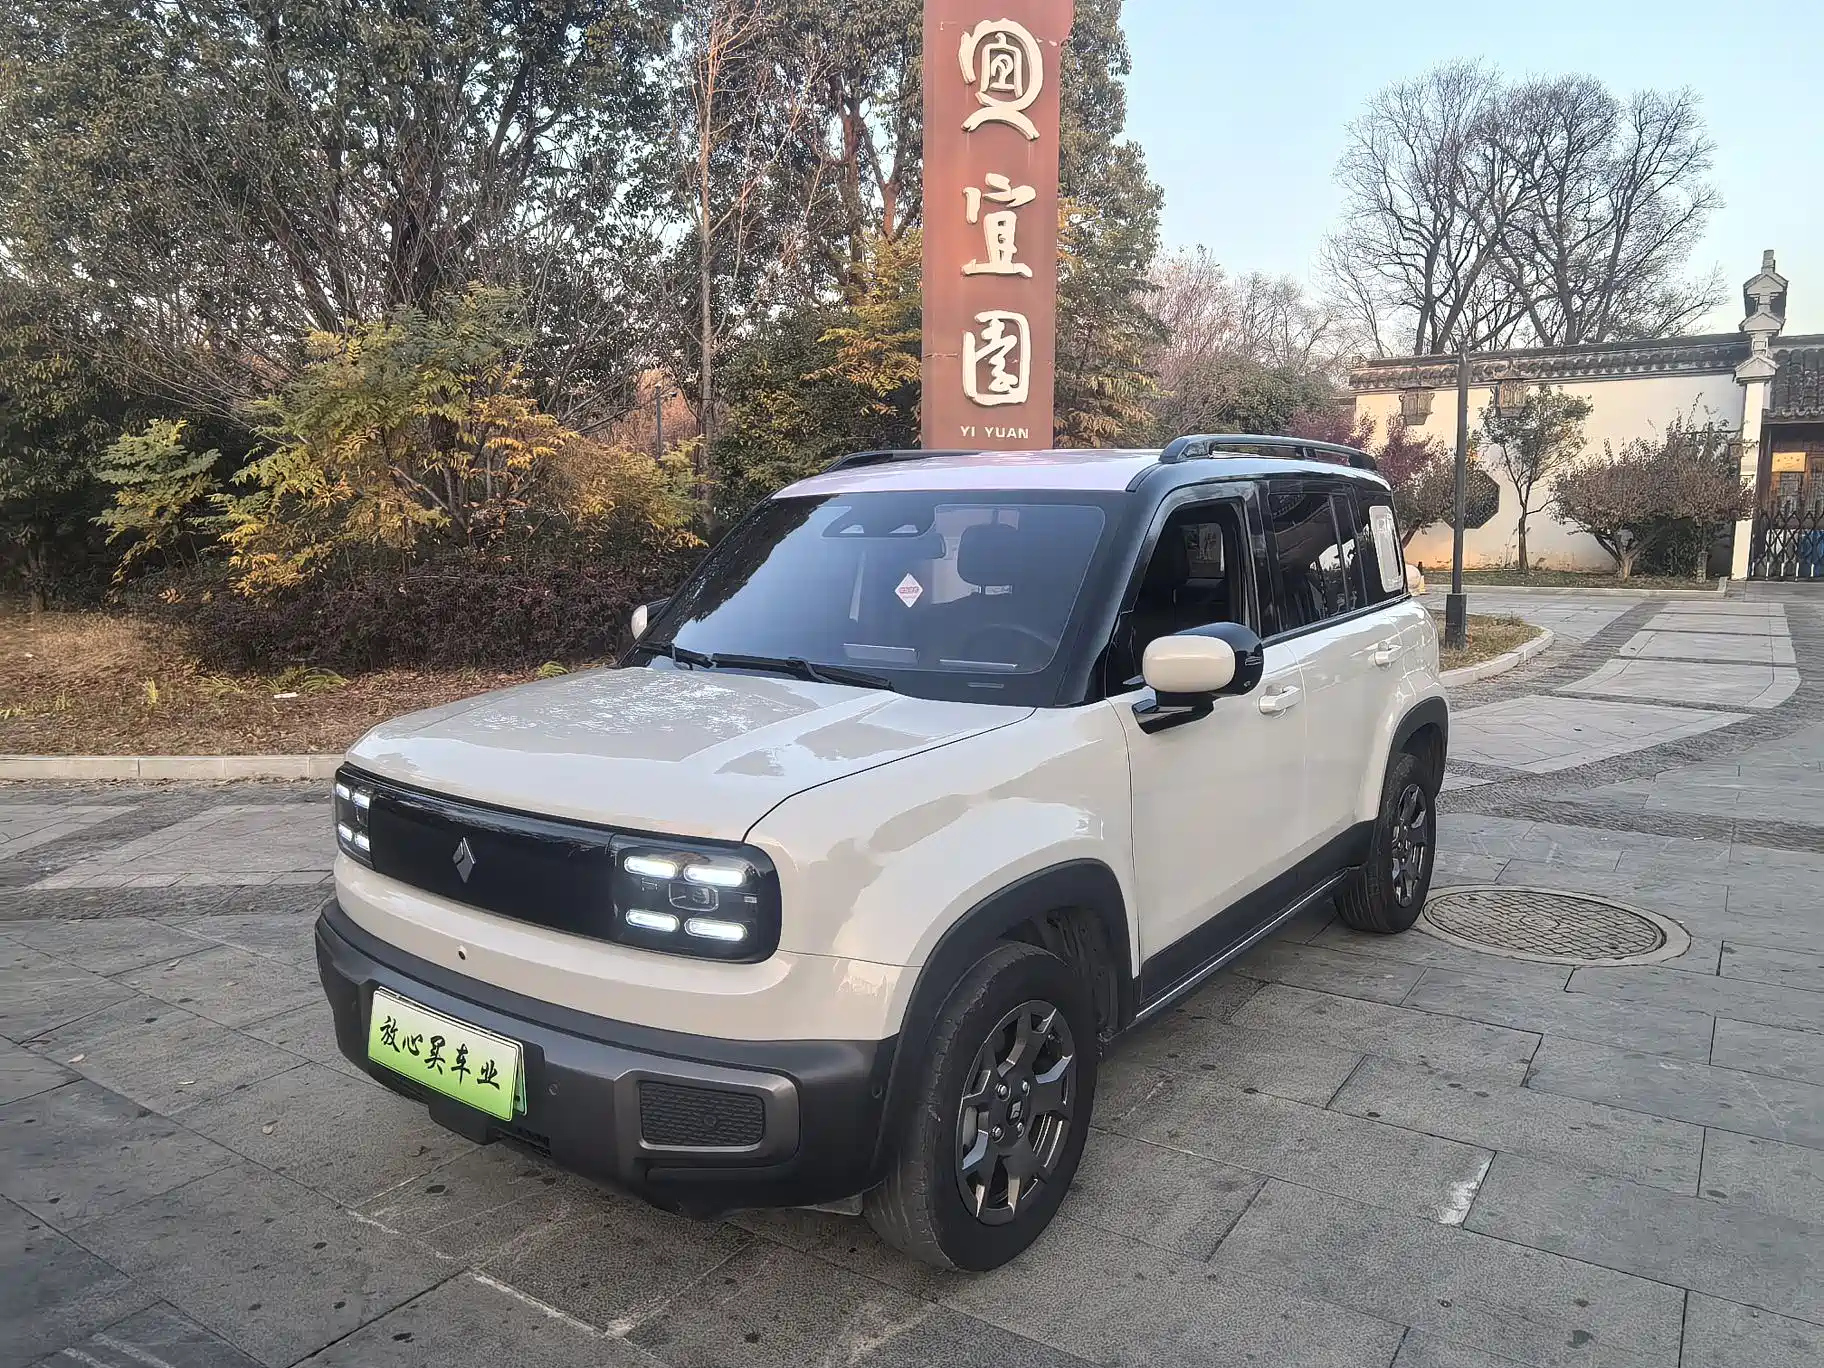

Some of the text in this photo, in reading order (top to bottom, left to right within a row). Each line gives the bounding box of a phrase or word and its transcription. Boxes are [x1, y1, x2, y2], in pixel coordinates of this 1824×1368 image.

[960, 425, 1029, 439] YI YUAN
[379, 1015, 501, 1090] 放心买车业
